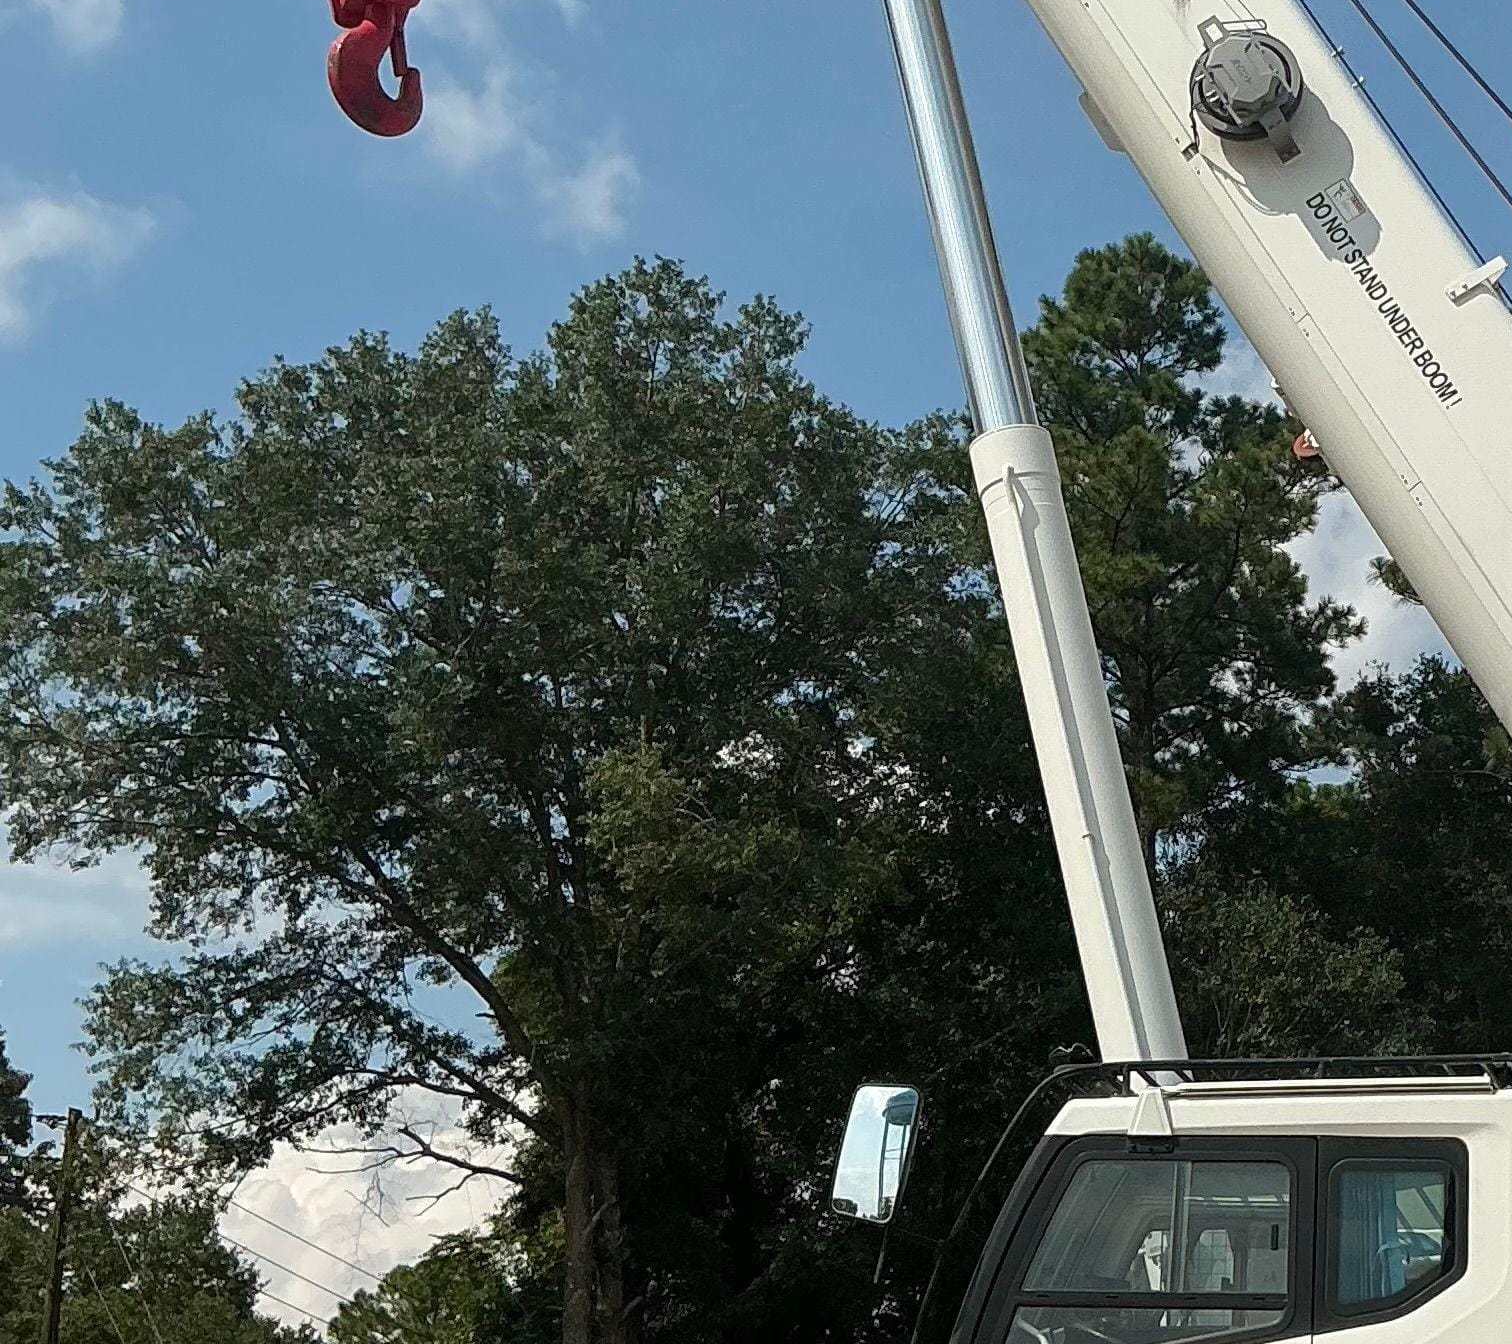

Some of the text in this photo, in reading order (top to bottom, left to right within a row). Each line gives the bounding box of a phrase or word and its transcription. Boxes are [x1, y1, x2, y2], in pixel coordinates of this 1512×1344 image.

[1305, 191, 1331, 220] DO
[1321, 215, 1356, 251] NOT
[1343, 247, 1388, 301] STAND
[1378, 296, 1425, 356] UNDER
